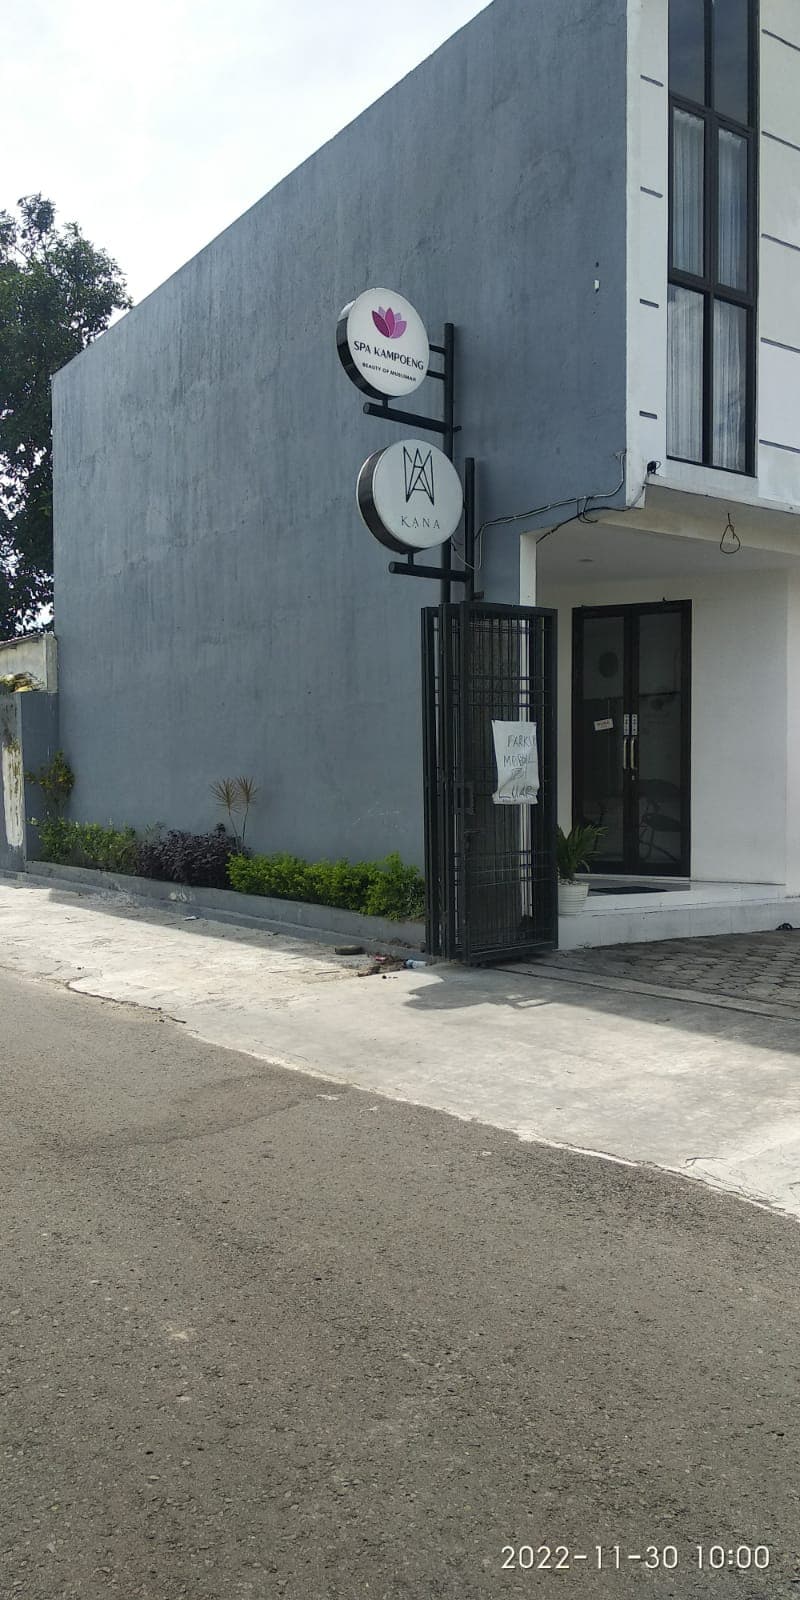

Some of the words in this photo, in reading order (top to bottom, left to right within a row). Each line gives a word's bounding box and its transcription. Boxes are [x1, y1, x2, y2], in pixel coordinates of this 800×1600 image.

[353, 340, 372, 354] SPA
[374, 346, 424, 371] KAMPOENG
[362, 362, 381, 372] BEAUTY
[382, 367, 390, 375] OF
[400, 515, 441, 530] KANA
